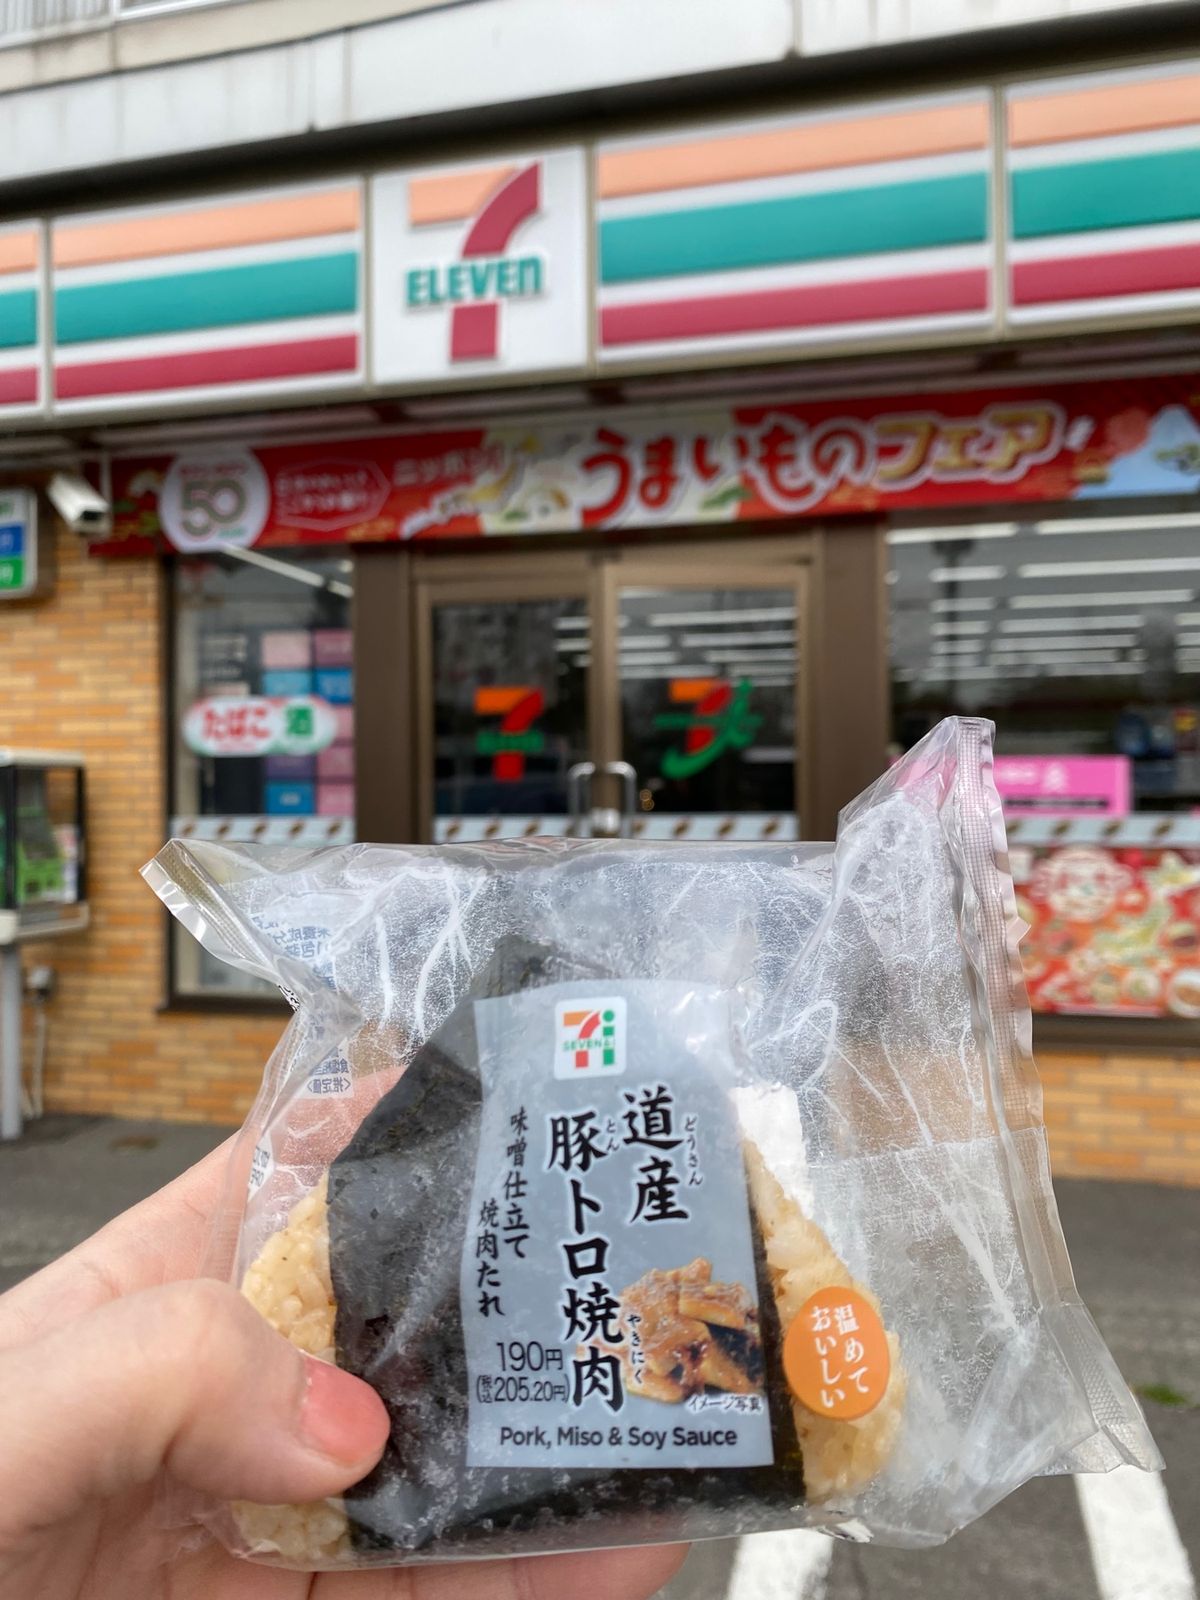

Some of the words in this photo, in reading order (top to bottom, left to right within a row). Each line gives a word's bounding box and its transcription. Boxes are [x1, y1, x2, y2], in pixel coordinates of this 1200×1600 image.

[181, 477, 247, 537] 50
[605, 1118, 620, 1151] とん
[621, 1084, 690, 1224] 道産
[684, 1116, 704, 1186] どうさん
[502, 1106, 531, 1260] 味噌仕立て
[475, 1198, 506, 1318] 焼肉たれ
[547, 1111, 625, 1413] 豚トロ焼肉
[496, 1341, 564, 1372] 190円
[627, 1314, 645, 1384] やきにく
[810, 1305, 846, 1408] おいしい
[833, 1303, 871, 1394] 温めて
[500, 1425, 551, 1450] Pork,
[557, 1426, 604, 1446] Miso
[608, 1426, 622, 1446] &
[628, 1426, 667, 1451] Soy
[672, 1426, 738, 1447] Sauce
[688, 1395, 762, 1412] イメージ写真
